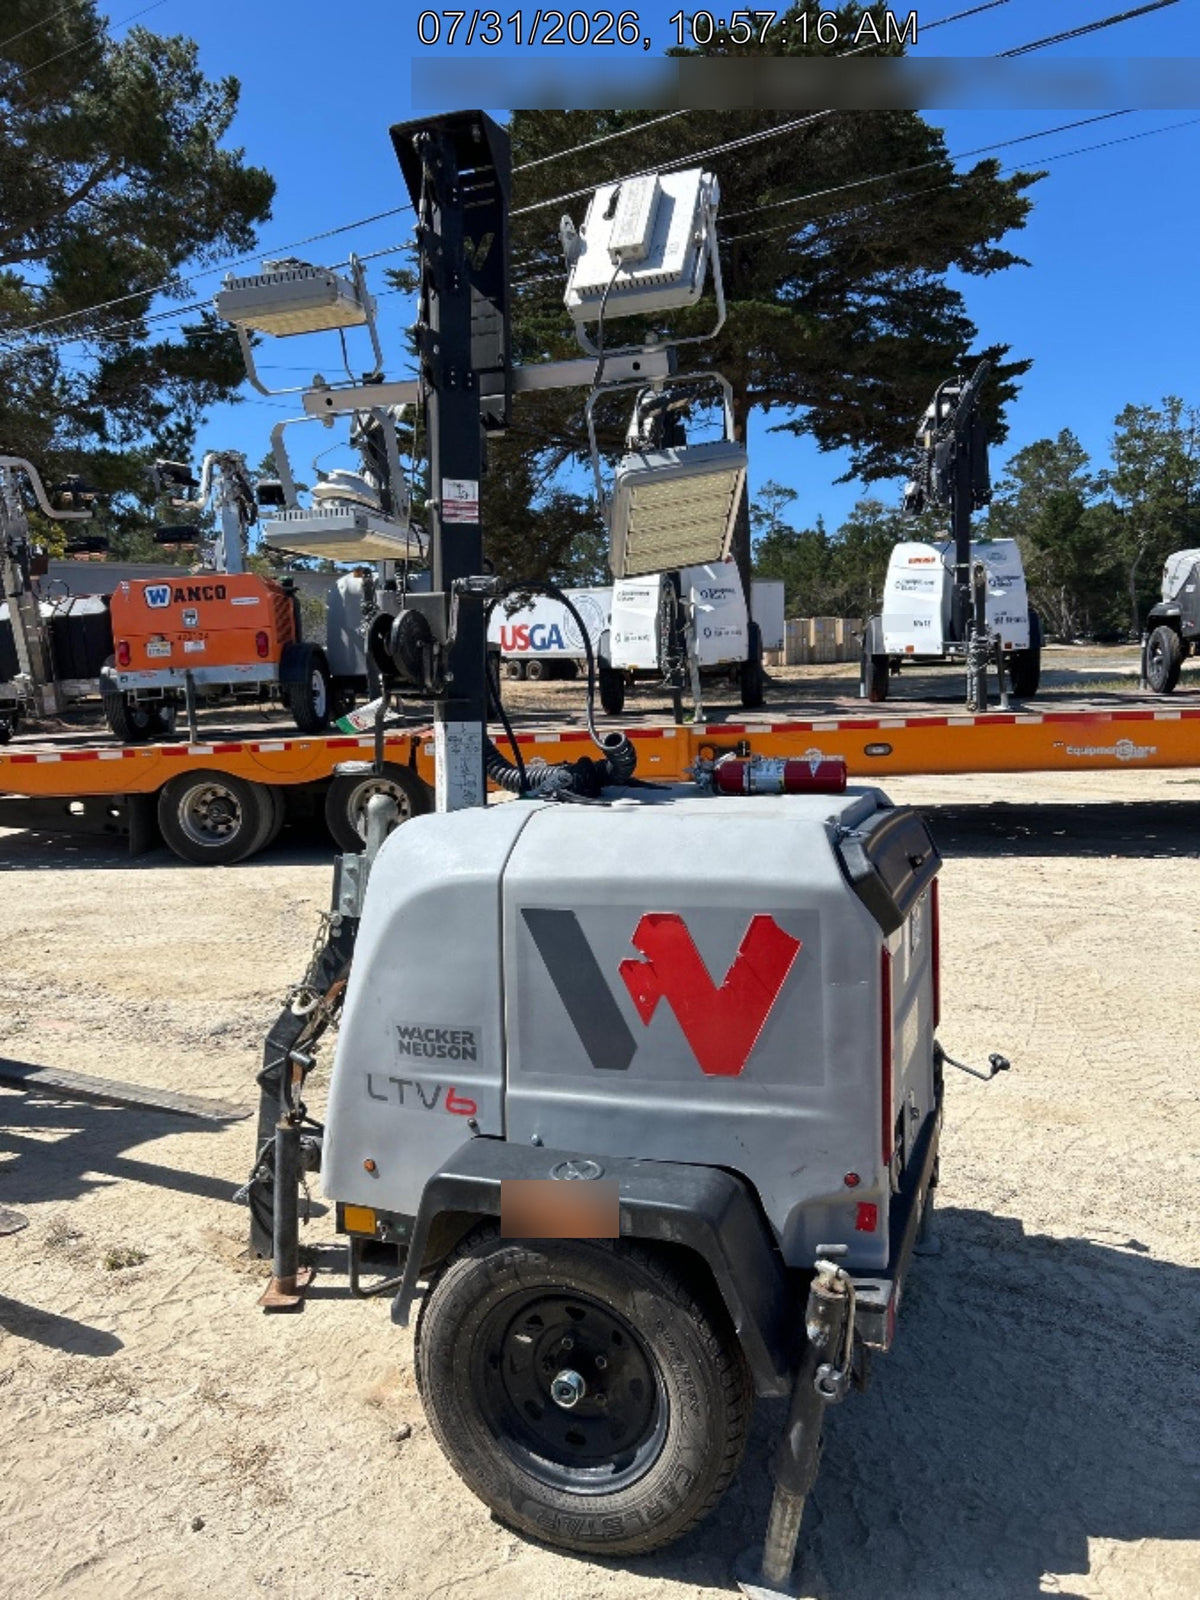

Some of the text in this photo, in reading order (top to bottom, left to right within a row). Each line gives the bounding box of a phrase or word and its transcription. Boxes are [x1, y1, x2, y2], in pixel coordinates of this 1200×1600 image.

[146, 585, 226, 606] WANCO
[500, 624, 564, 651] USGA
[396, 1025, 476, 1046] WACKER
[398, 1040, 477, 1061] NEUSON
[367, 1073, 477, 1116] LTV6
